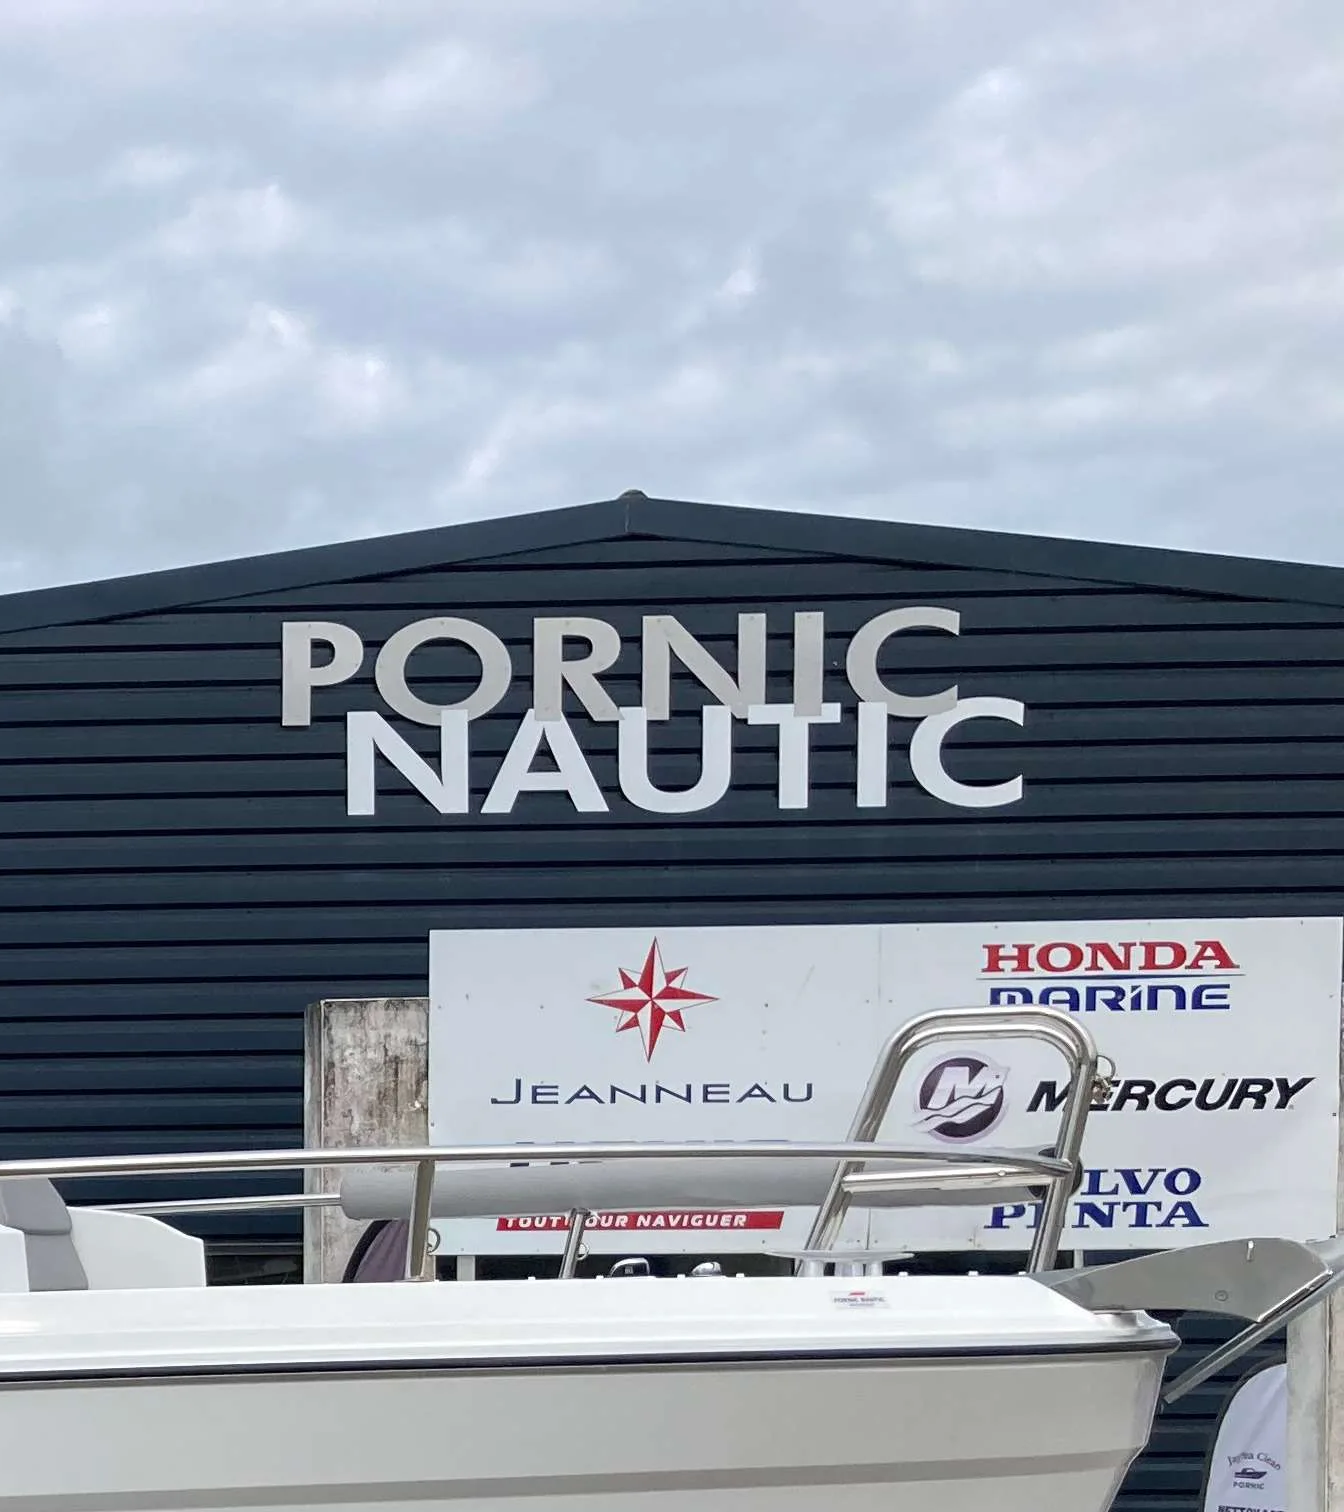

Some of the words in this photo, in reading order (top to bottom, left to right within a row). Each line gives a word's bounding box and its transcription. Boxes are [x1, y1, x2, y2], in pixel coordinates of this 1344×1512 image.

[282, 606, 960, 727] PORNIC
[346, 696, 1025, 816] NAUTIC
[981, 940, 1241, 973] HONDA
[490, 1078, 813, 1105] JEANNEAU
[1080, 1167, 1203, 1196] LVO
[505, 1215, 563, 1229] TOUT
[564, 1214, 629, 1228] OUR
[636, 1213, 748, 1228] NAVIGUER
[983, 1200, 1210, 1229] PNTA
